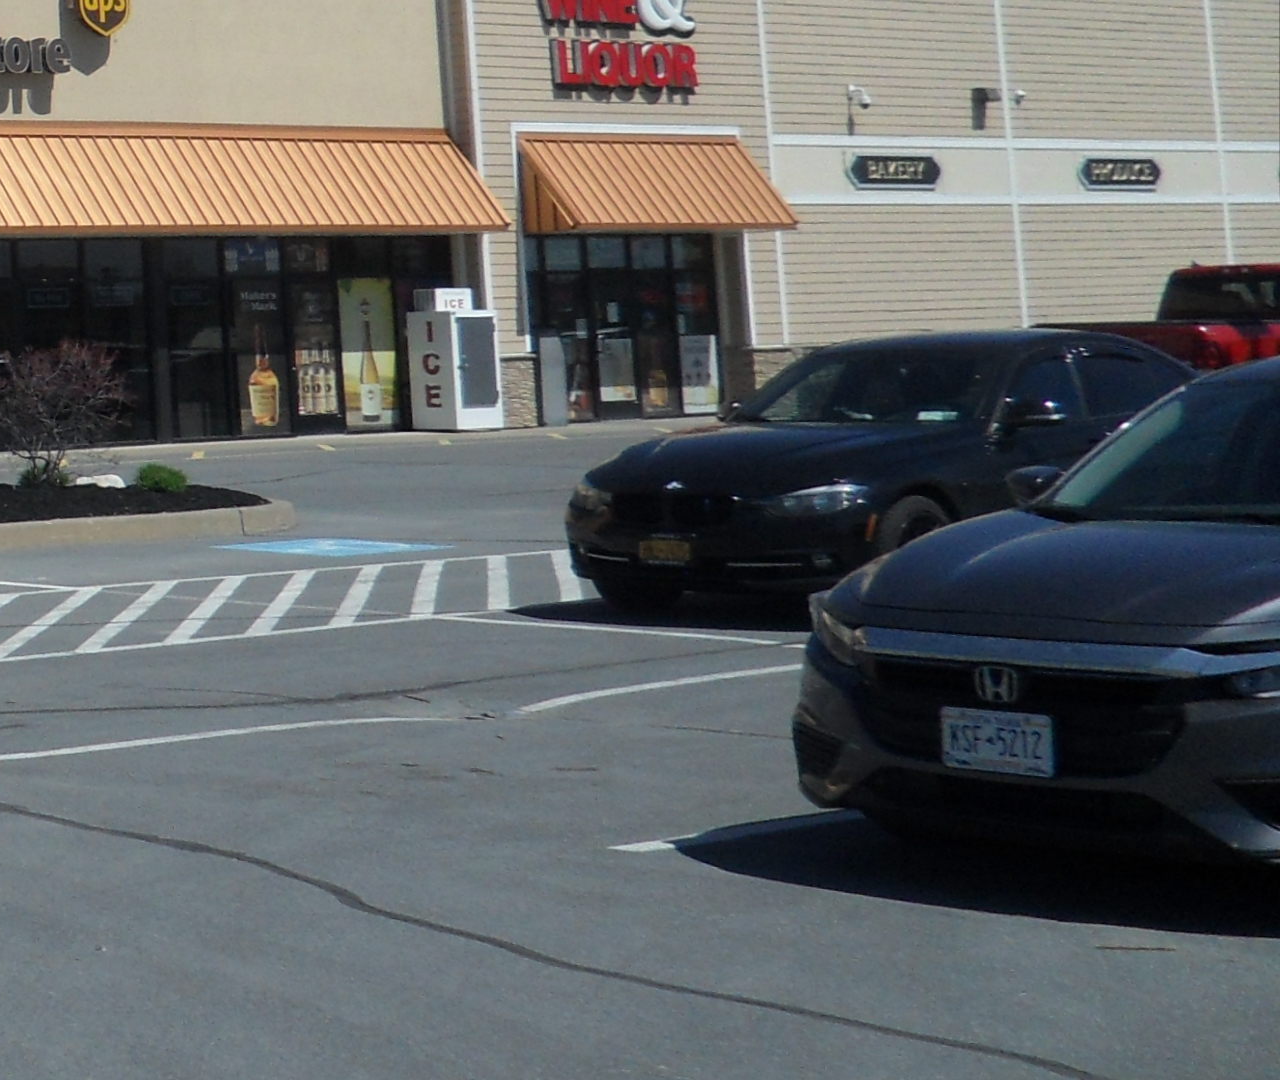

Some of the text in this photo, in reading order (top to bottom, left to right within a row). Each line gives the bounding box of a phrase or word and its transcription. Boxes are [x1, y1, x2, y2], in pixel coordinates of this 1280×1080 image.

[551, 39, 698, 89] LIQUOR
[867, 160, 925, 180] BAKERY
[1090, 162, 1155, 181] PRODUCE
[444, 299, 465, 309] ICE
[422, 321, 443, 408] ICE
